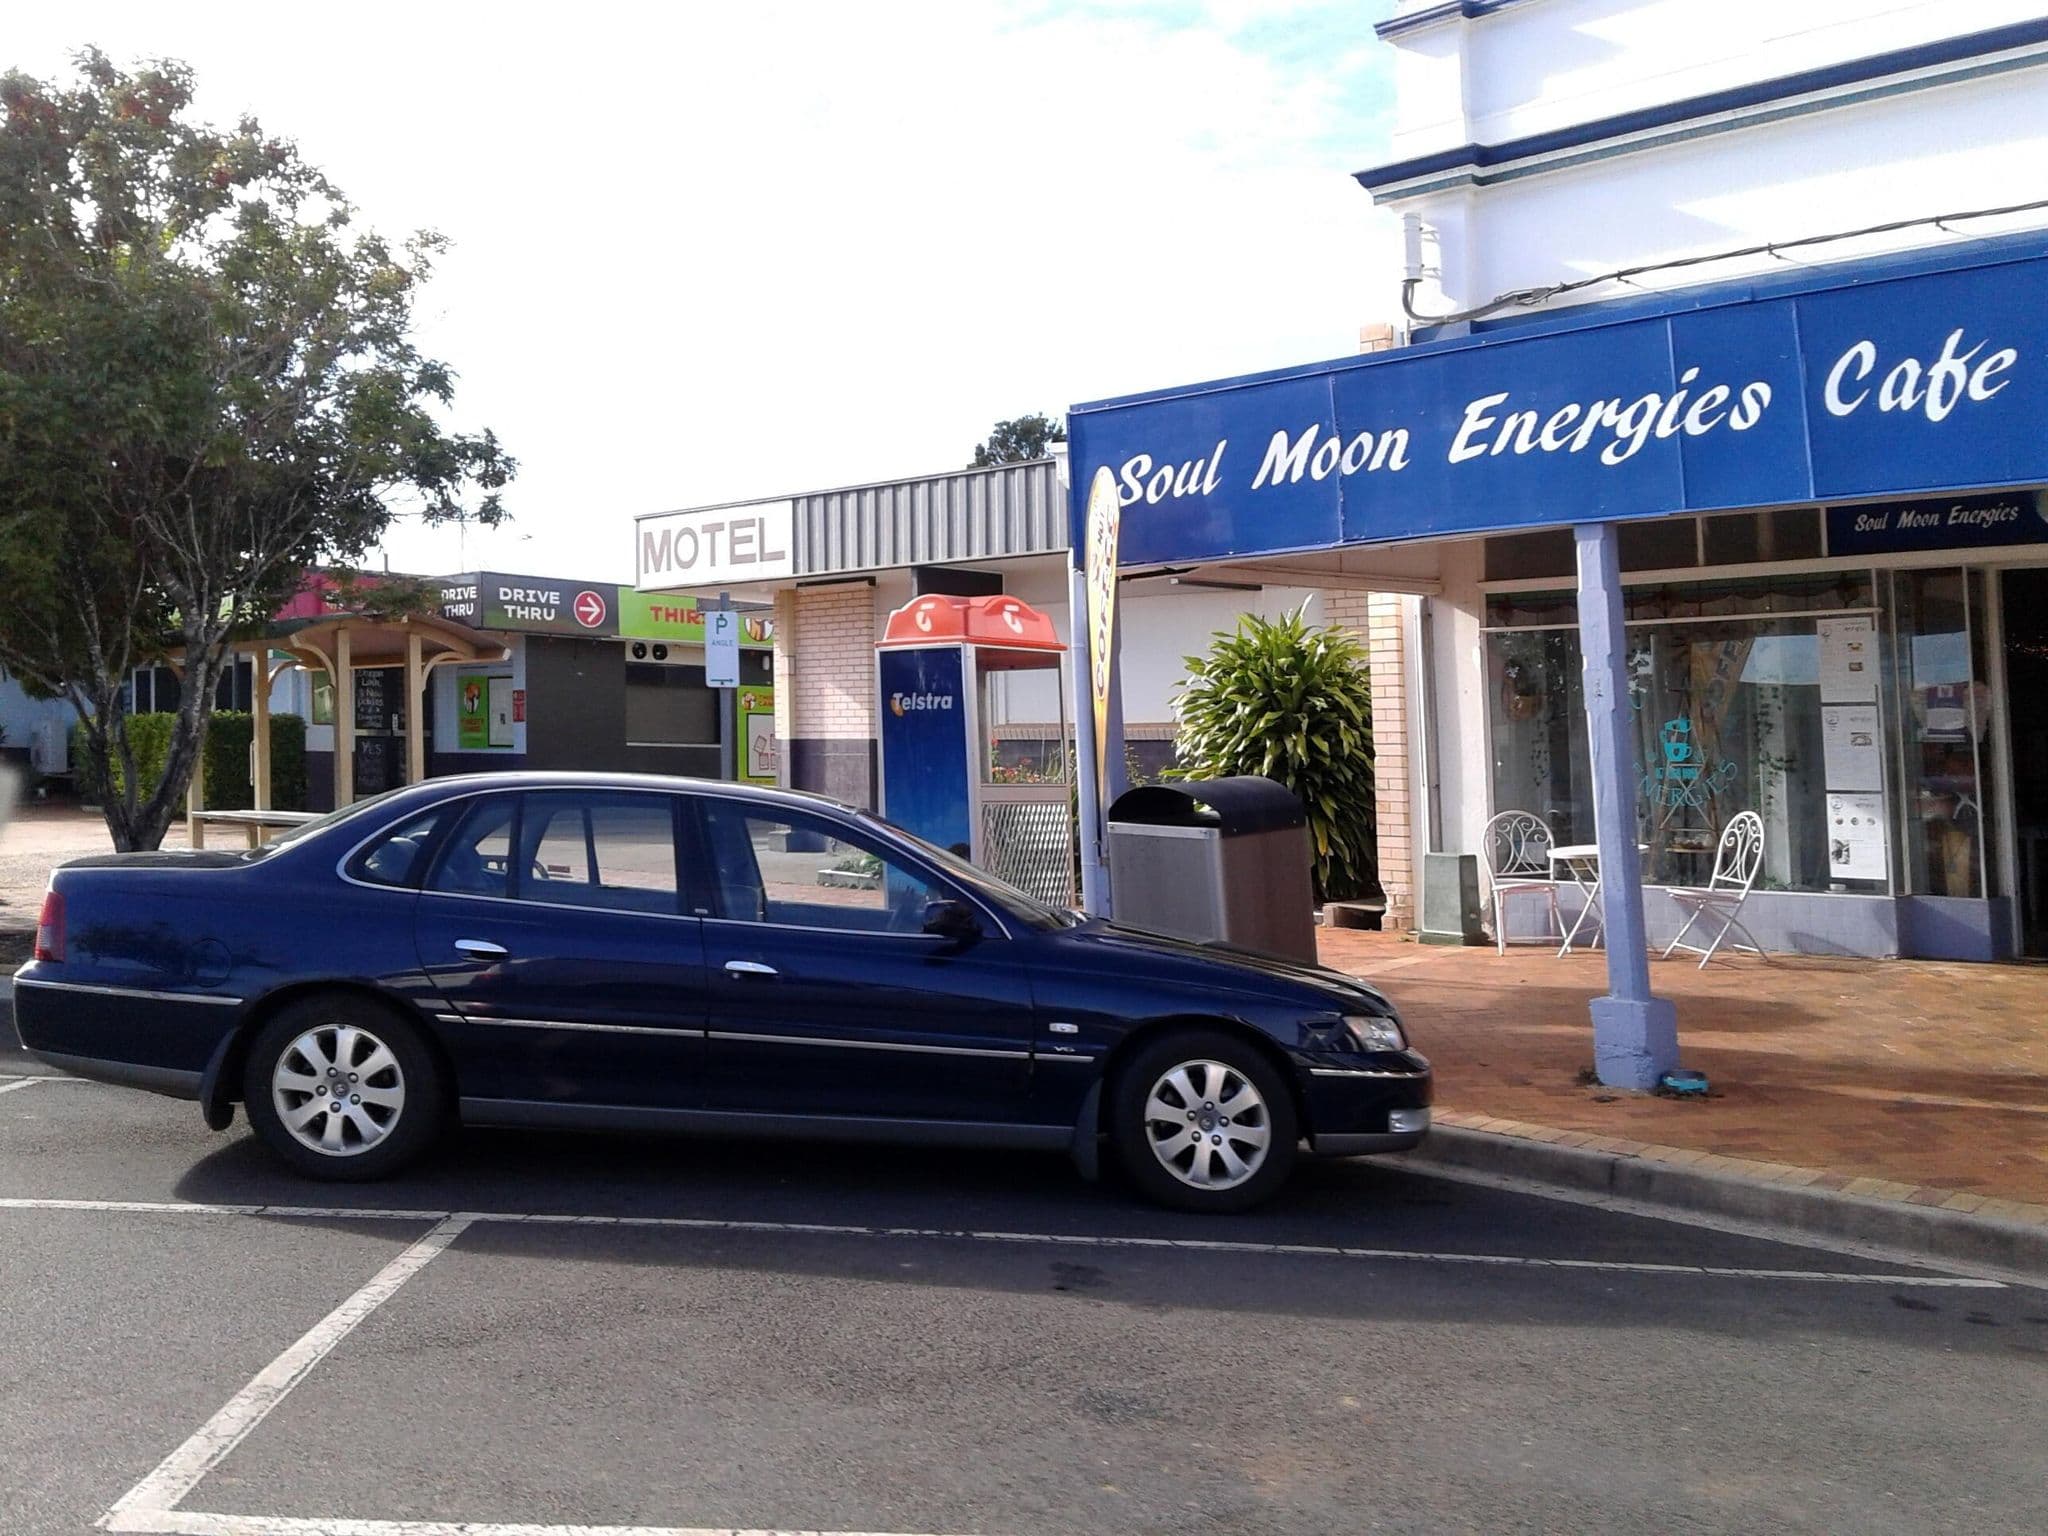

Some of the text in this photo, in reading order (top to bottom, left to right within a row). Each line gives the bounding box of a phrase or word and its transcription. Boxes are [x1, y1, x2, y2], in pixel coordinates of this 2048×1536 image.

[1118, 328, 2017, 507] Soul Moon Energies Cafe
[1855, 503, 2019, 532] Soul Moon Energies
[644, 517, 785, 574] MOTEL
[441, 586, 477, 600] DRIVE
[499, 587, 560, 604] DRIVE
[444, 603, 474, 617] THRU
[504, 605, 555, 620] THRU
[650, 605, 705, 624] THIR
[716, 616, 728, 635] P
[891, 692, 953, 716] Telstra
